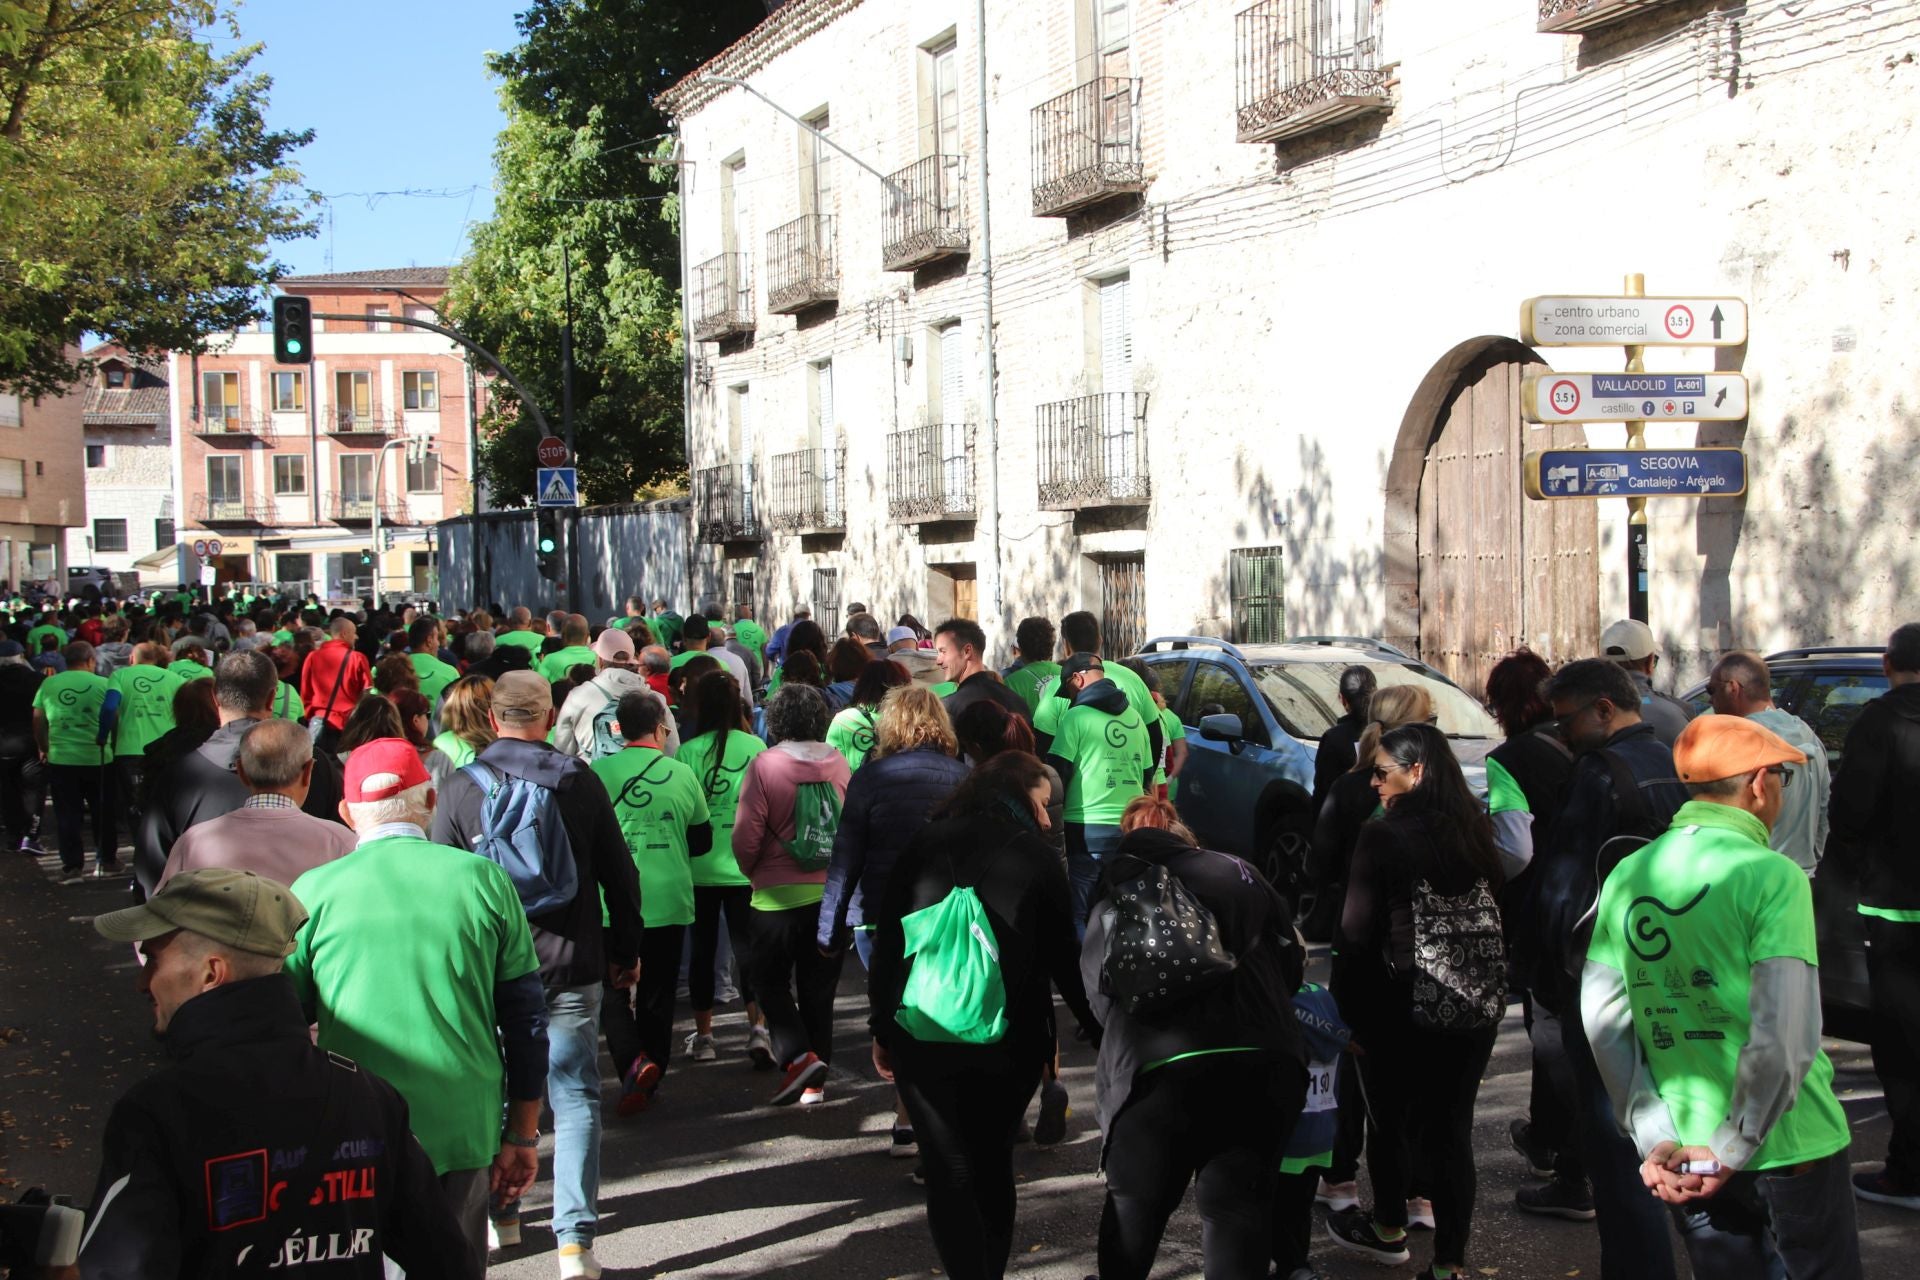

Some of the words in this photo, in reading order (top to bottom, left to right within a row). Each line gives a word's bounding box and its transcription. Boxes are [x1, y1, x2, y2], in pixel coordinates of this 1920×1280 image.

[1554, 305, 1593, 318] centro
[1597, 305, 1640, 318] urbano
[1554, 324, 1585, 336] zona
[1588, 322, 1648, 336] comercial
[1596, 379, 1667, 392] VALLADOLID
[1676, 380, 1701, 390] A-601
[1601, 400, 1635, 414] castillo
[540, 446, 565, 459] STOP
[1640, 456, 1699, 470] SEGOVIA
[1628, 475, 1677, 490] Cantalejo
[1686, 474, 1725, 487] Arévalo
